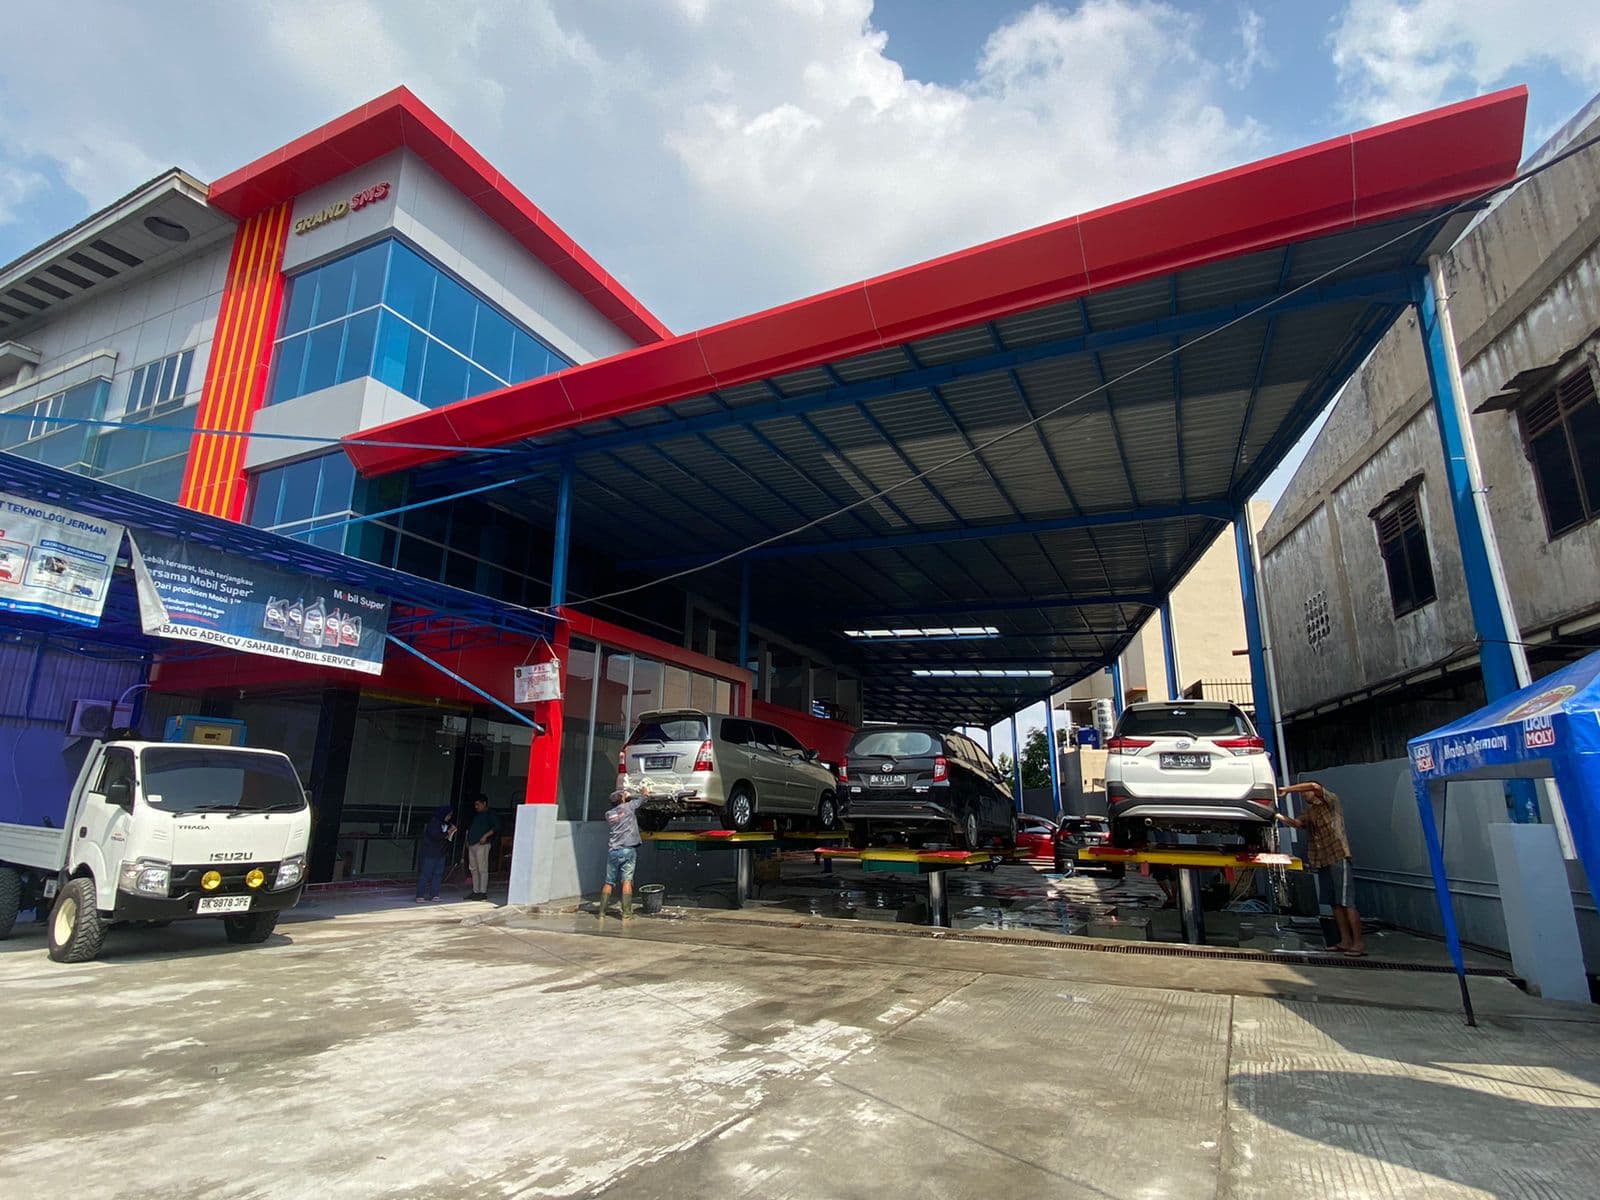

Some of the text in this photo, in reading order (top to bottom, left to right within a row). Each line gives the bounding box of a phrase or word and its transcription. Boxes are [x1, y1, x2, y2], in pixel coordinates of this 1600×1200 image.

[295, 182, 391, 235] GRAND SMS
[8, 502, 66, 523] TEKNOLOGI
[66, 519, 107, 535] JERMAN
[142, 554, 164, 565] Lebih
[198, 567, 215, 577] lebih
[216, 573, 253, 586] terjangkau
[148, 569, 187, 582] ersama
[190, 575, 218, 591] Mobil
[155, 581, 171, 590] Dari
[172, 585, 207, 599] produsen
[208, 593, 228, 603] Mobil
[333, 589, 385, 610] Mobil Super
[321, 655, 356, 667] SERVICE
[1525, 716, 1552, 731] LIQUI
[1526, 729, 1553, 745] MOLY
[1443, 740, 1465, 760] Made
[209, 852, 253, 862] ISUZU
[201, 899, 211, 908] BK
